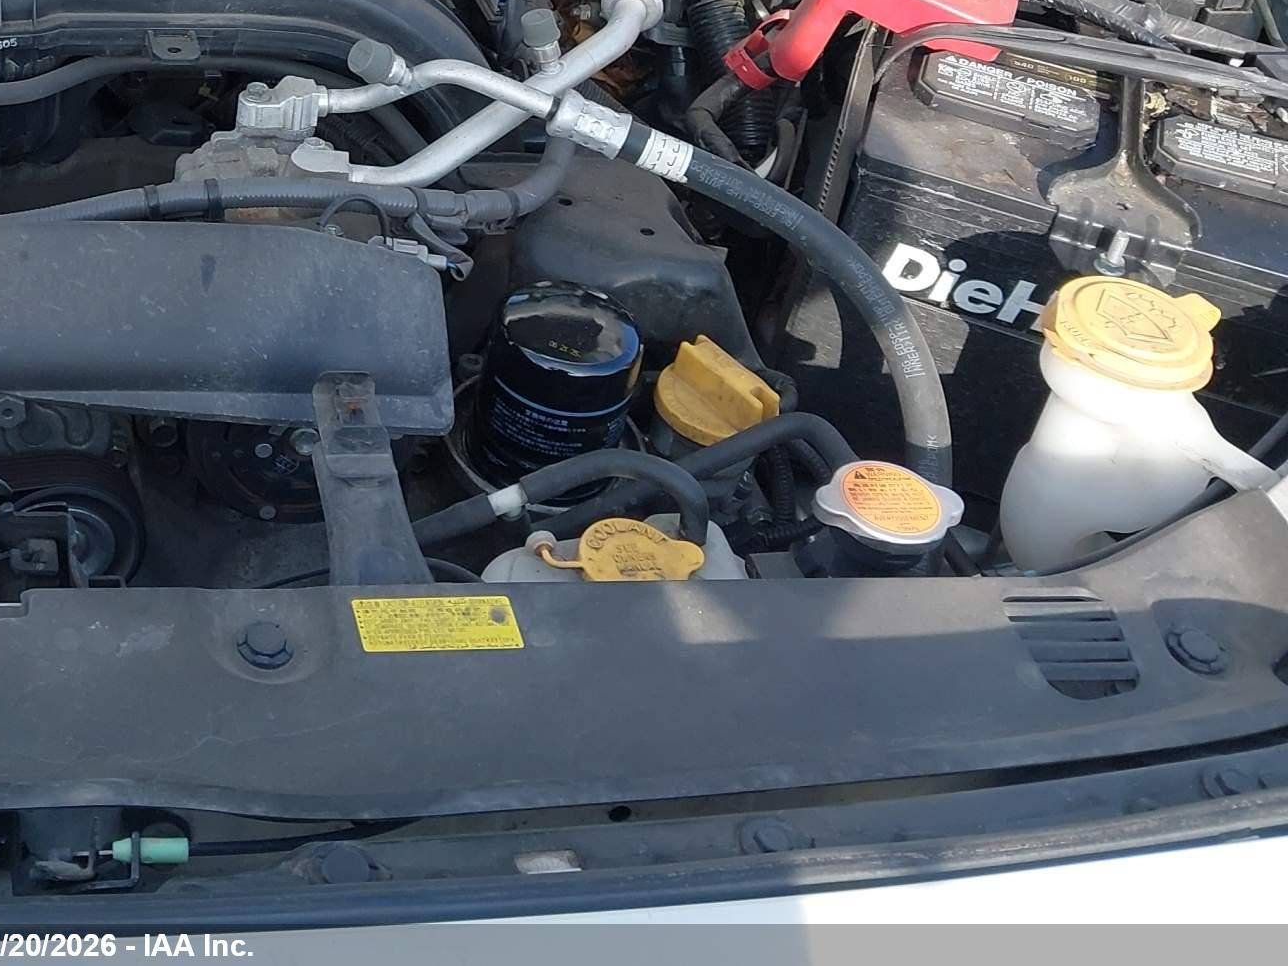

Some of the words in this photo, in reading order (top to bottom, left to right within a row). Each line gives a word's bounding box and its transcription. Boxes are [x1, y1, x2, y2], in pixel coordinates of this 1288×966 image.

[958, 58, 1013, 79] DANGER
[1026, 77, 1077, 97] POISON
[586, 522, 668, 550] COOLANT
